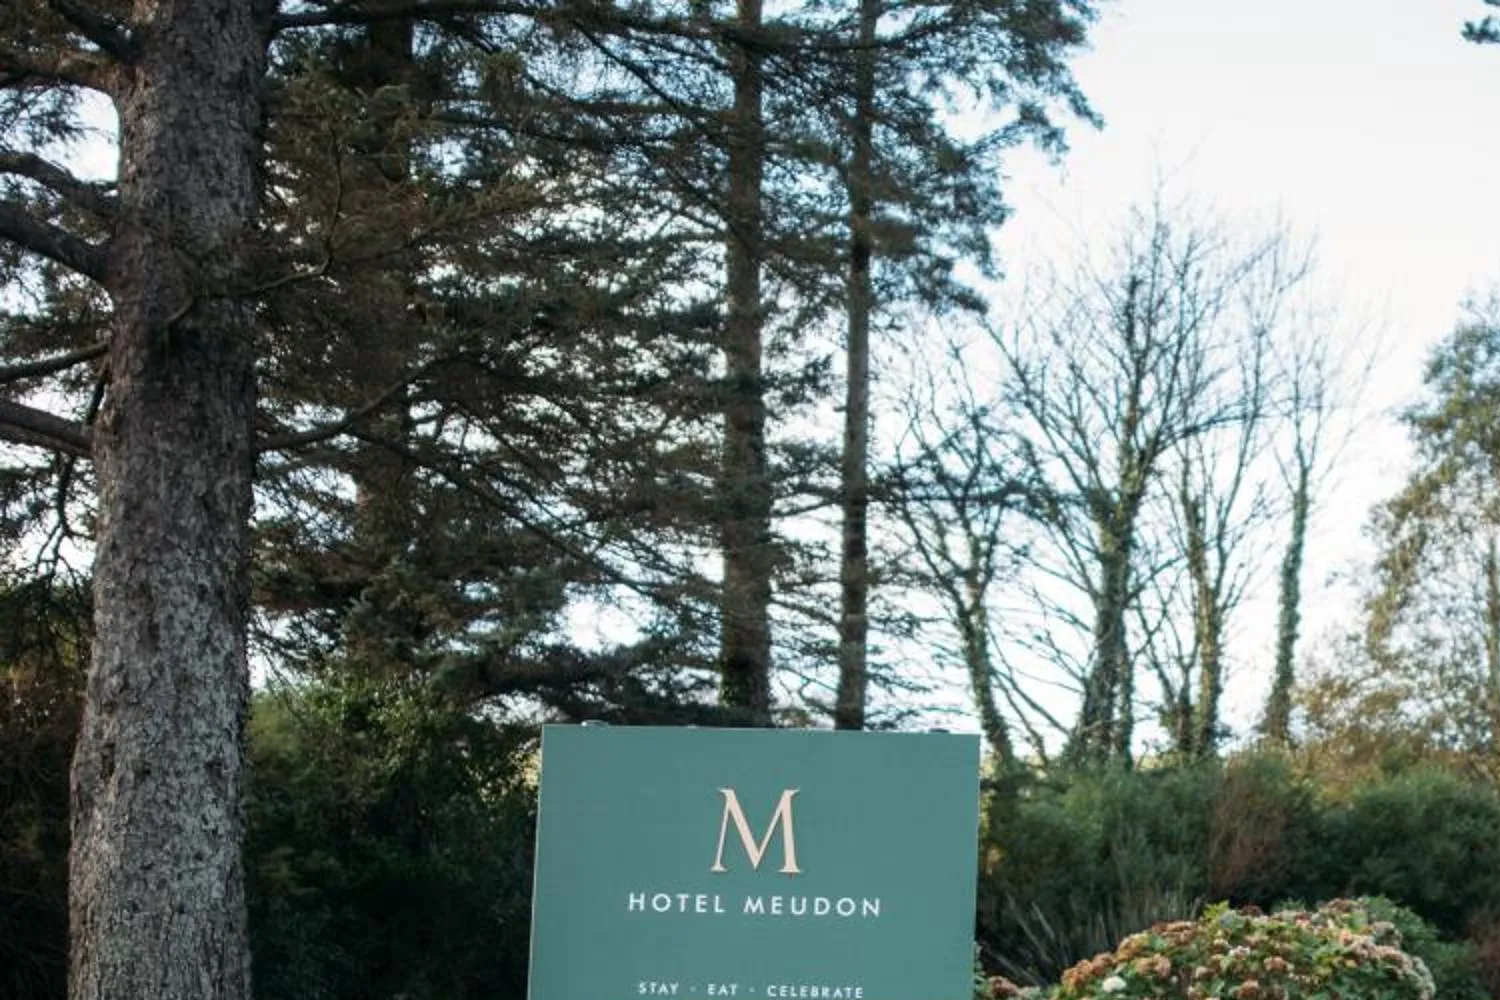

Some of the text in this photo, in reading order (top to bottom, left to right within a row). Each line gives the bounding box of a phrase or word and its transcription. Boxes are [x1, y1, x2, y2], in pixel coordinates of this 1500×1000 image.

[709, 787, 801, 874] M
[628, 892, 881, 918] HOTEL MEUDON
[638, 981, 863, 999] STAY EAT CELEBRATE
